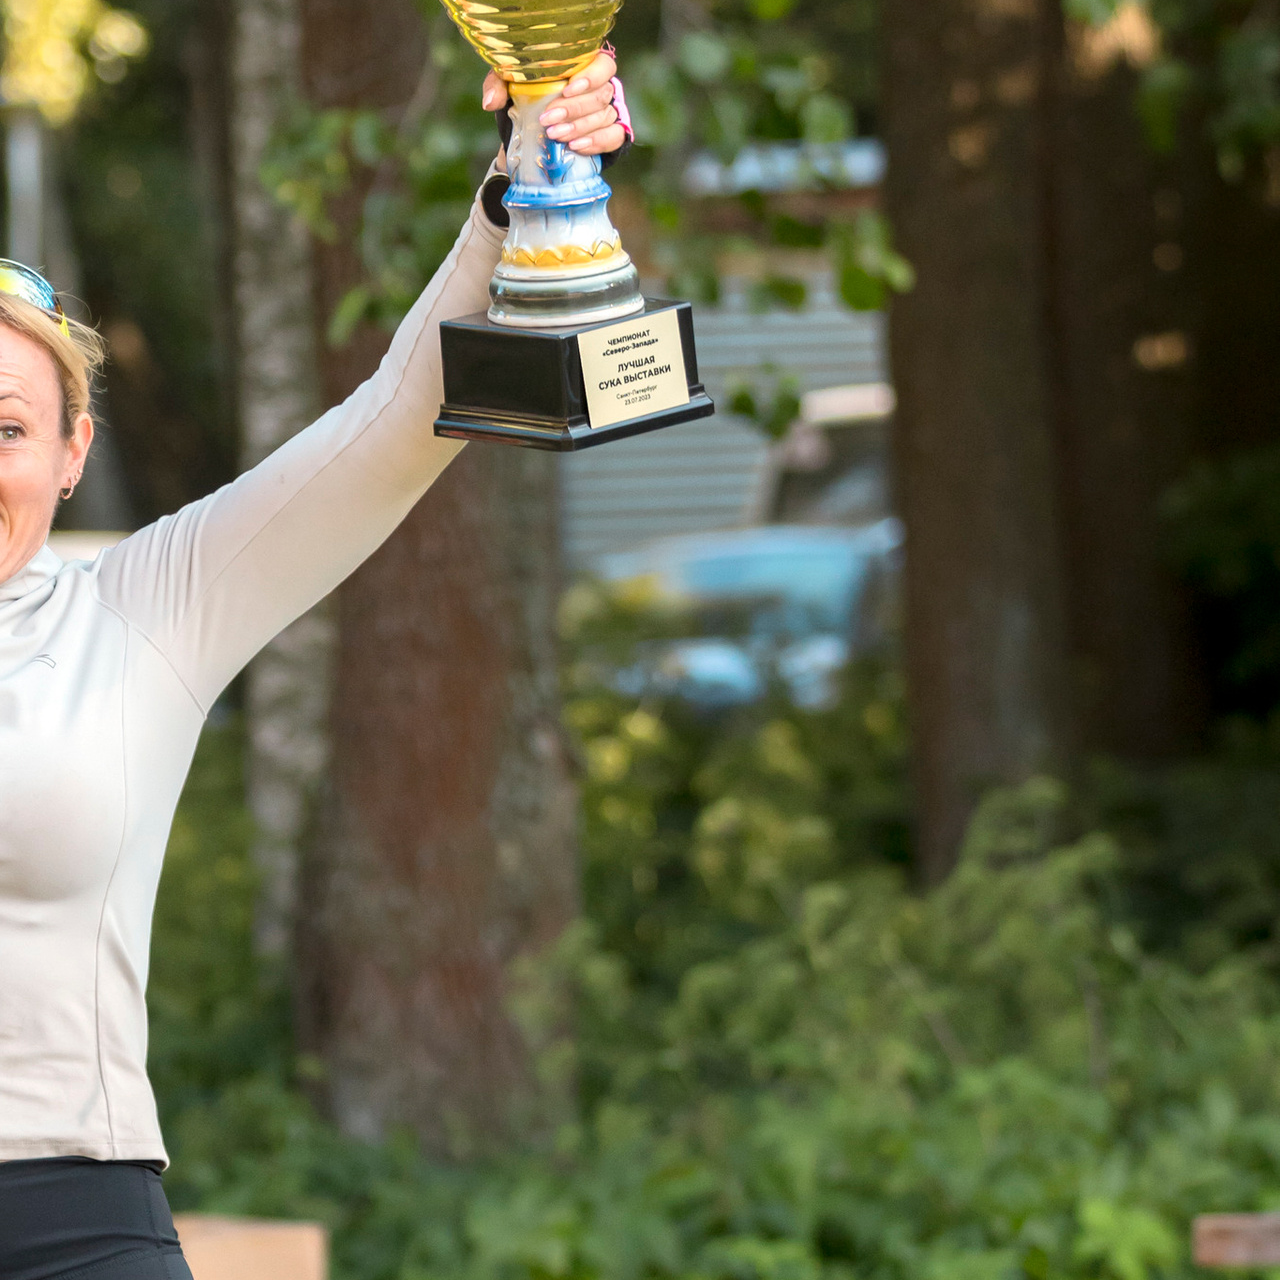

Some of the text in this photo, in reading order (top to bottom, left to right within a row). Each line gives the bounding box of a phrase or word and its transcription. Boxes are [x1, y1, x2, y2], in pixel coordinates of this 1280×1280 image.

[608, 329, 650, 346] ЧЕМПИОНАТ
[602, 338, 658, 357] «Северо-Запада»
[617, 355, 655, 373] ЛУЧШАЯ
[598, 364, 671, 391] СУКА ВЫСТАВКИ
[624, 394, 651, 406] 23.07.2023
